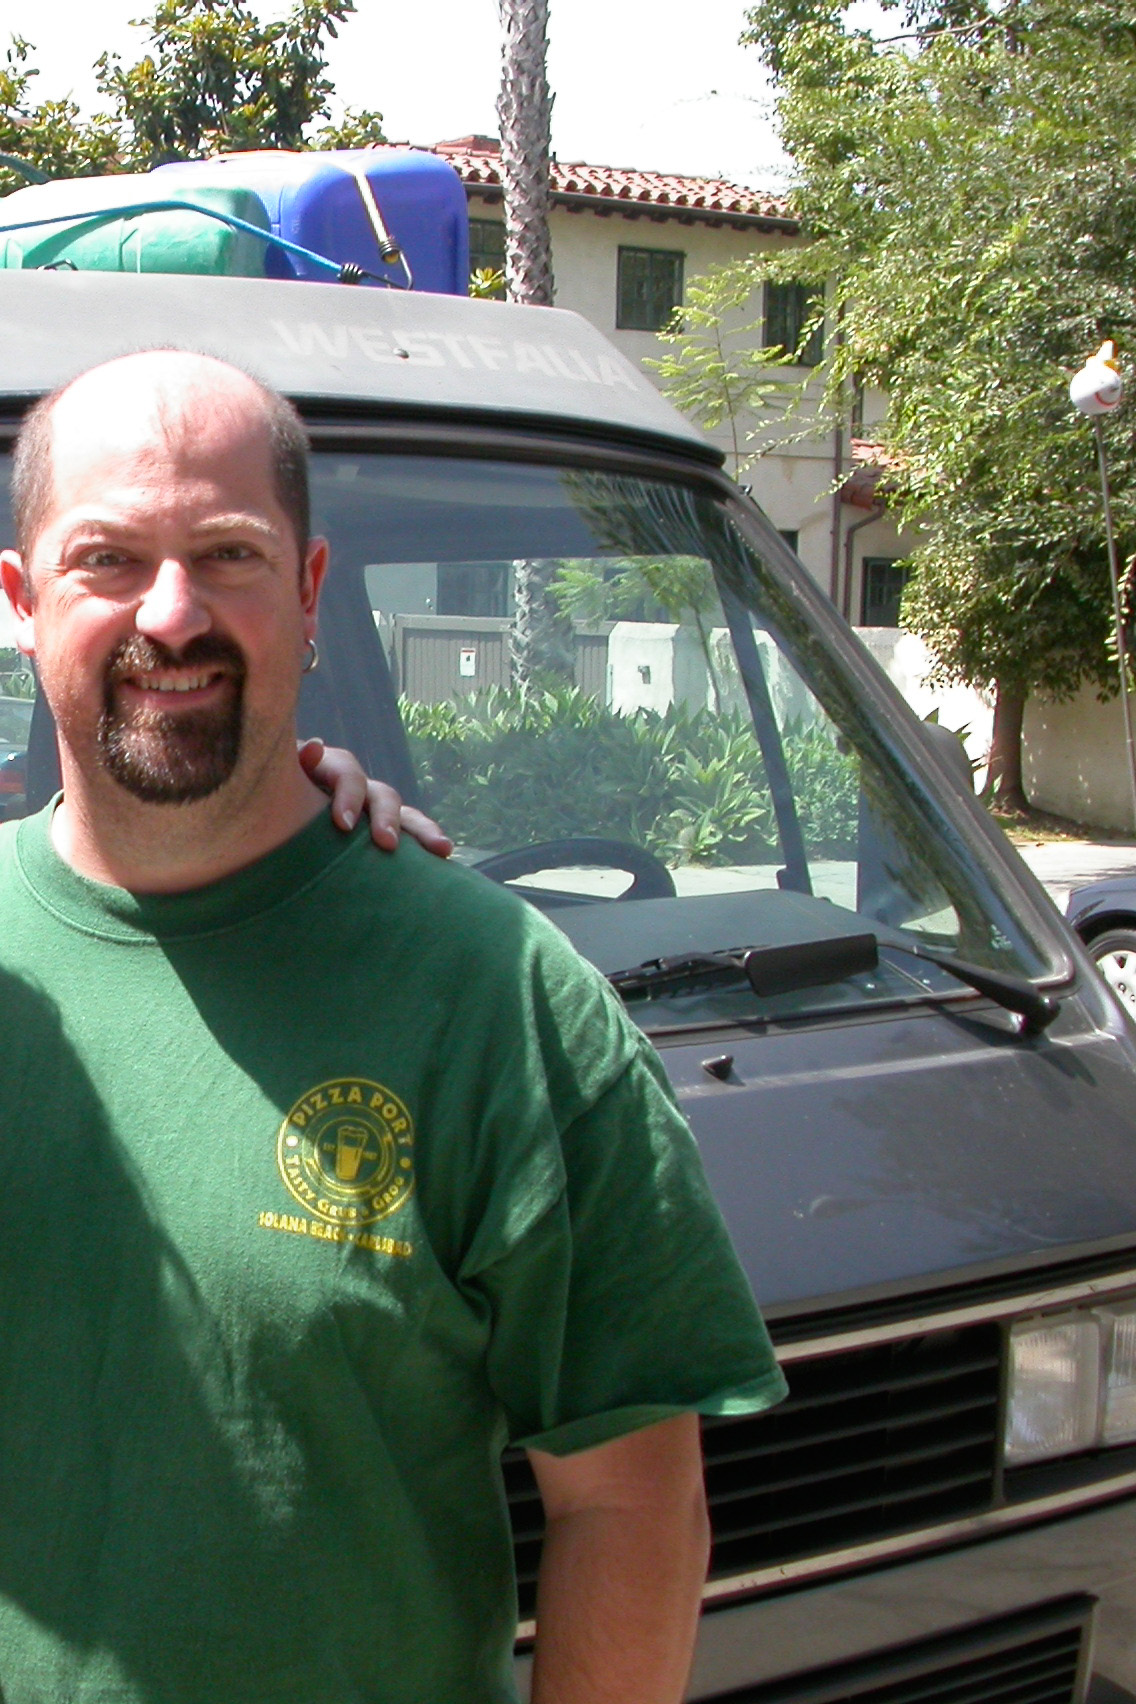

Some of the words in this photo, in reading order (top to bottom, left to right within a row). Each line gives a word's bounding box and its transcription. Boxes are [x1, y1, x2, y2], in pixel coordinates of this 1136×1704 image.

[270, 319, 640, 391] WESTFALIA
[292, 1086, 362, 1127] PIZZA
[370, 1092, 413, 1146] PORT
